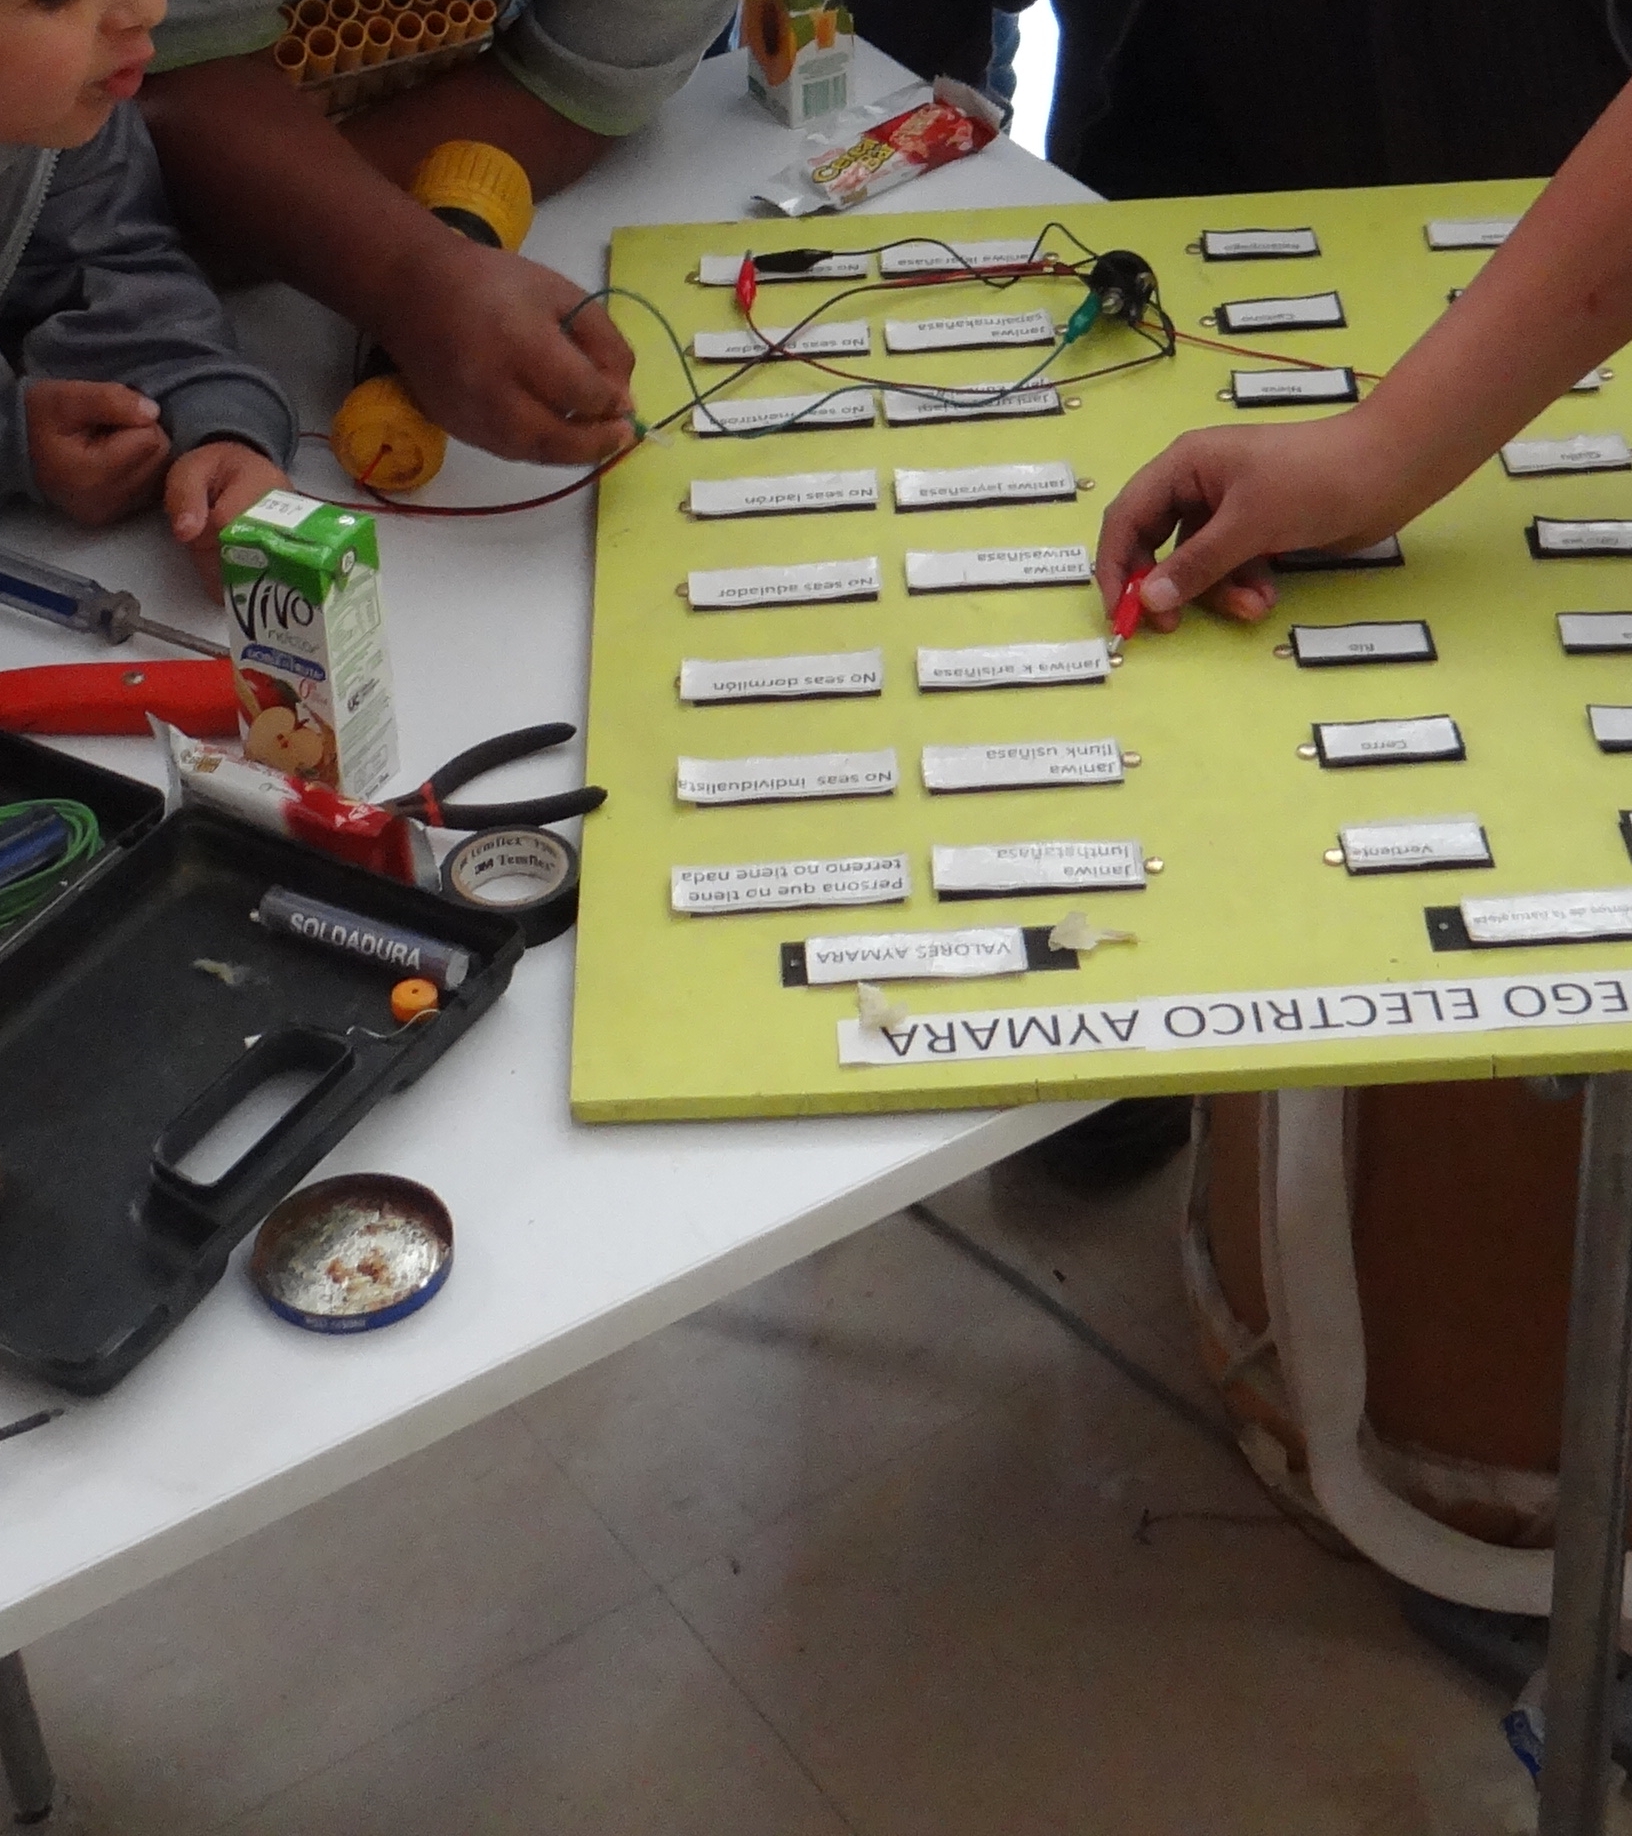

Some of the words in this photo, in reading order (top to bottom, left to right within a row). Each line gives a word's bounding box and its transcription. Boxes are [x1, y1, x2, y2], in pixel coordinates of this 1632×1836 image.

[798, 340, 837, 349] seas
[842, 338, 864, 348] No
[842, 405, 864, 414] No
[744, 492, 800, 506] ladrón
[806, 491, 844, 501] seas
[849, 487, 873, 498] No
[804, 580, 842, 591] seas
[848, 577, 873, 587] No
[718, 584, 798, 598] adulador
[713, 678, 798, 692] dormilón
[804, 675, 844, 686] seas
[850, 672, 876, 684] No
[817, 774, 859, 786] seas
[865, 771, 892, 784] No
[678, 778, 805, 794] individualista
[736, 866, 788, 881] tiene
[795, 864, 819, 876] no
[826, 859, 901, 874] terreno
[681, 870, 729, 885] nada
[778, 883, 816, 897] que
[823, 878, 903, 894] Persona
[689, 890, 740, 904] tiene
[746, 888, 771, 899] no
[289, 911, 422, 972] SOLDADURA
[816, 949, 908, 964] AYMARA
[915, 943, 1011, 958] VALORES
[1164, 988, 1478, 1038] ELECTRICO
[880, 1010, 1139, 1057] AYMARA
